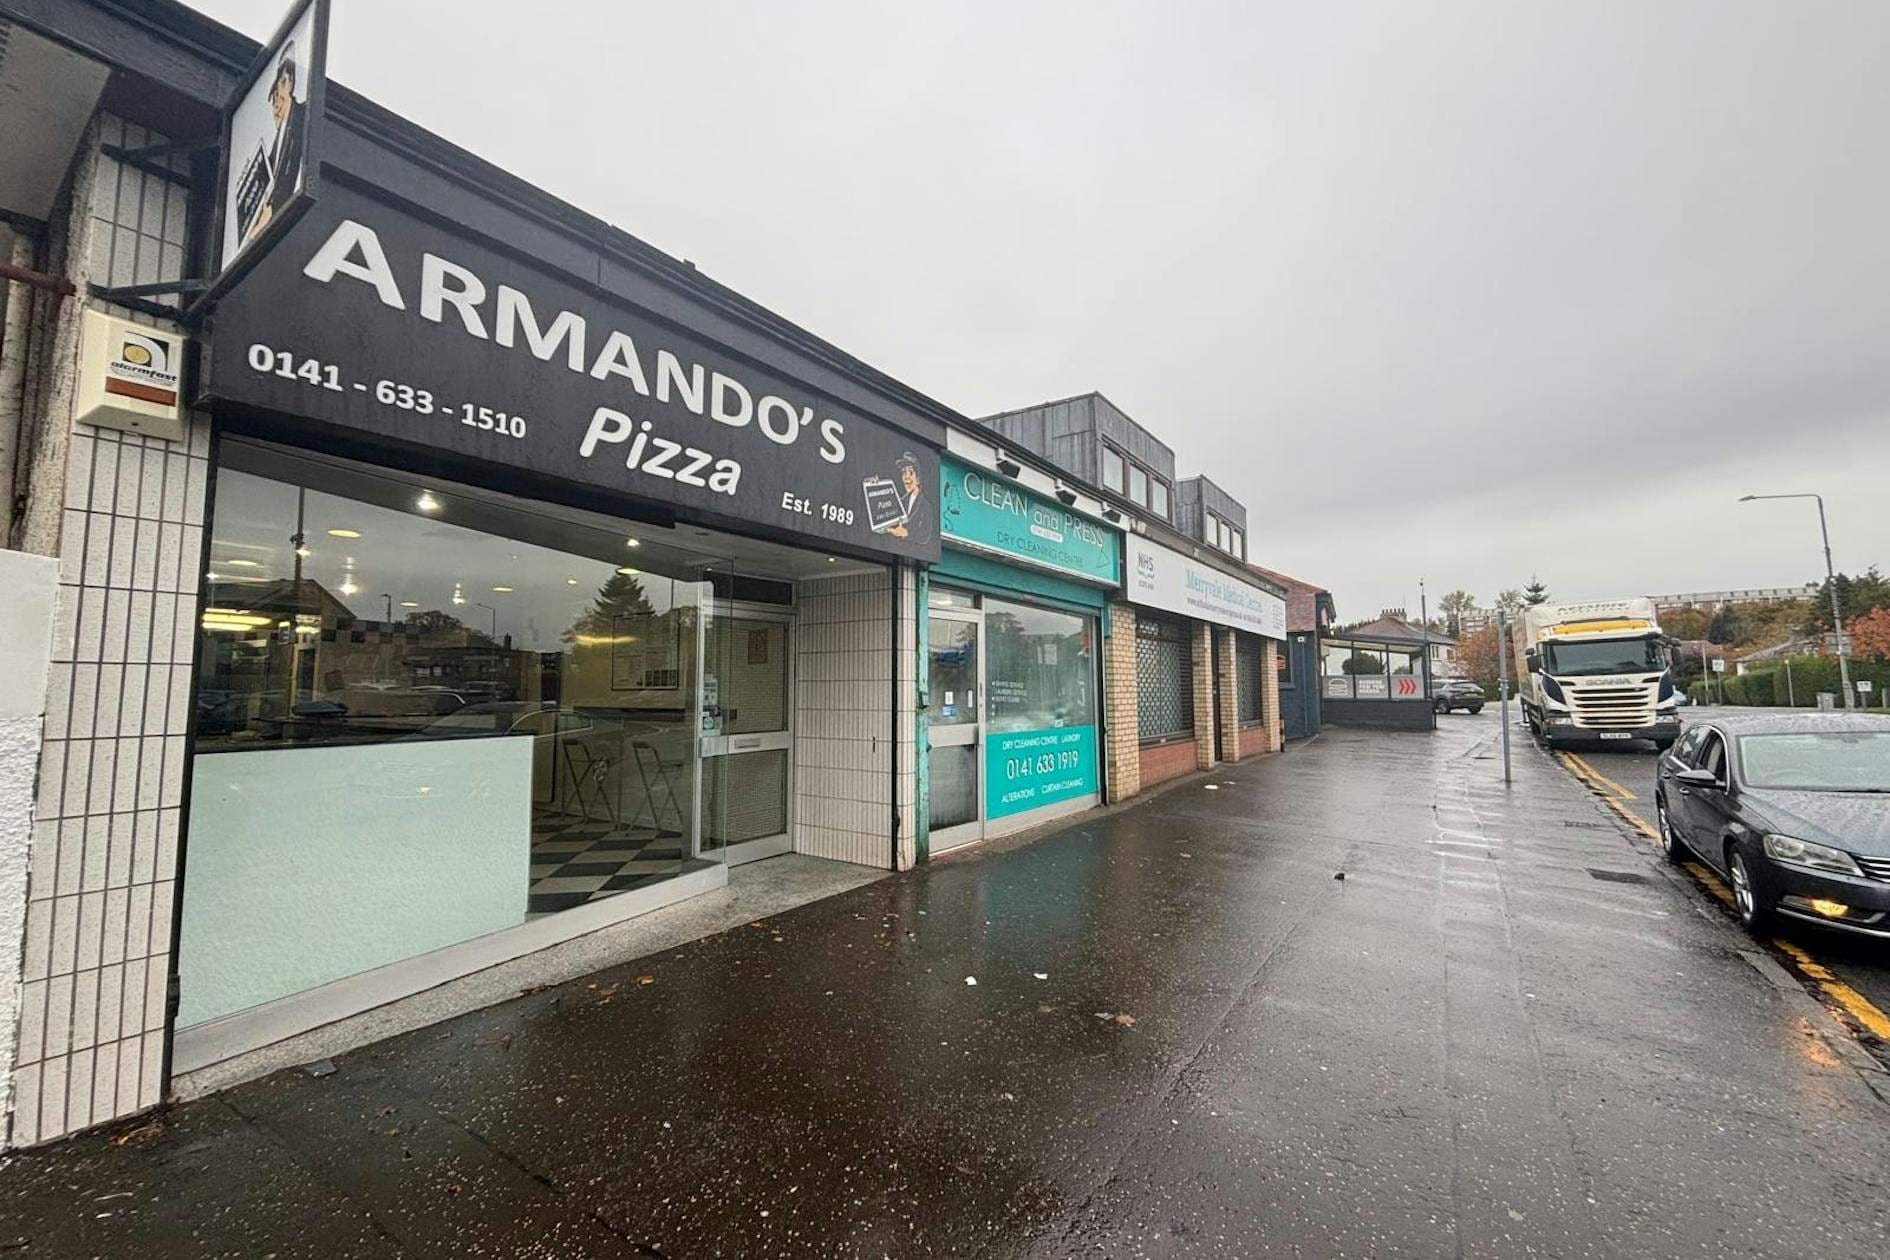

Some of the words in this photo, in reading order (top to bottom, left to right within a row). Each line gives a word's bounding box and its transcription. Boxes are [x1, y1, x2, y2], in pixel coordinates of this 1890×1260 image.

[304, 219, 847, 465] ARMANDO'S
[111, 361, 177, 382] alarmfast
[248, 344, 343, 392] 0141
[376, 380, 434, 414] 633
[461, 403, 526, 439] 1510
[579, 407, 742, 496] Pizza
[781, 491, 813, 516] Est.
[821, 503, 854, 526] 1989
[964, 472, 1028, 518] CLEAN
[1034, 511, 1059, 530] and
[997, 531, 1015, 546] DRY
[1138, 552, 1154, 572] NHS
[1585, 677, 1633, 687] SCANIA
[1002, 739, 1013, 751] DRY
[1014, 737, 1040, 749] CLEANING
[1006, 757, 1032, 780] 0141
[1036, 753, 1055, 774] 633
[1057, 750, 1079, 770] 1919
